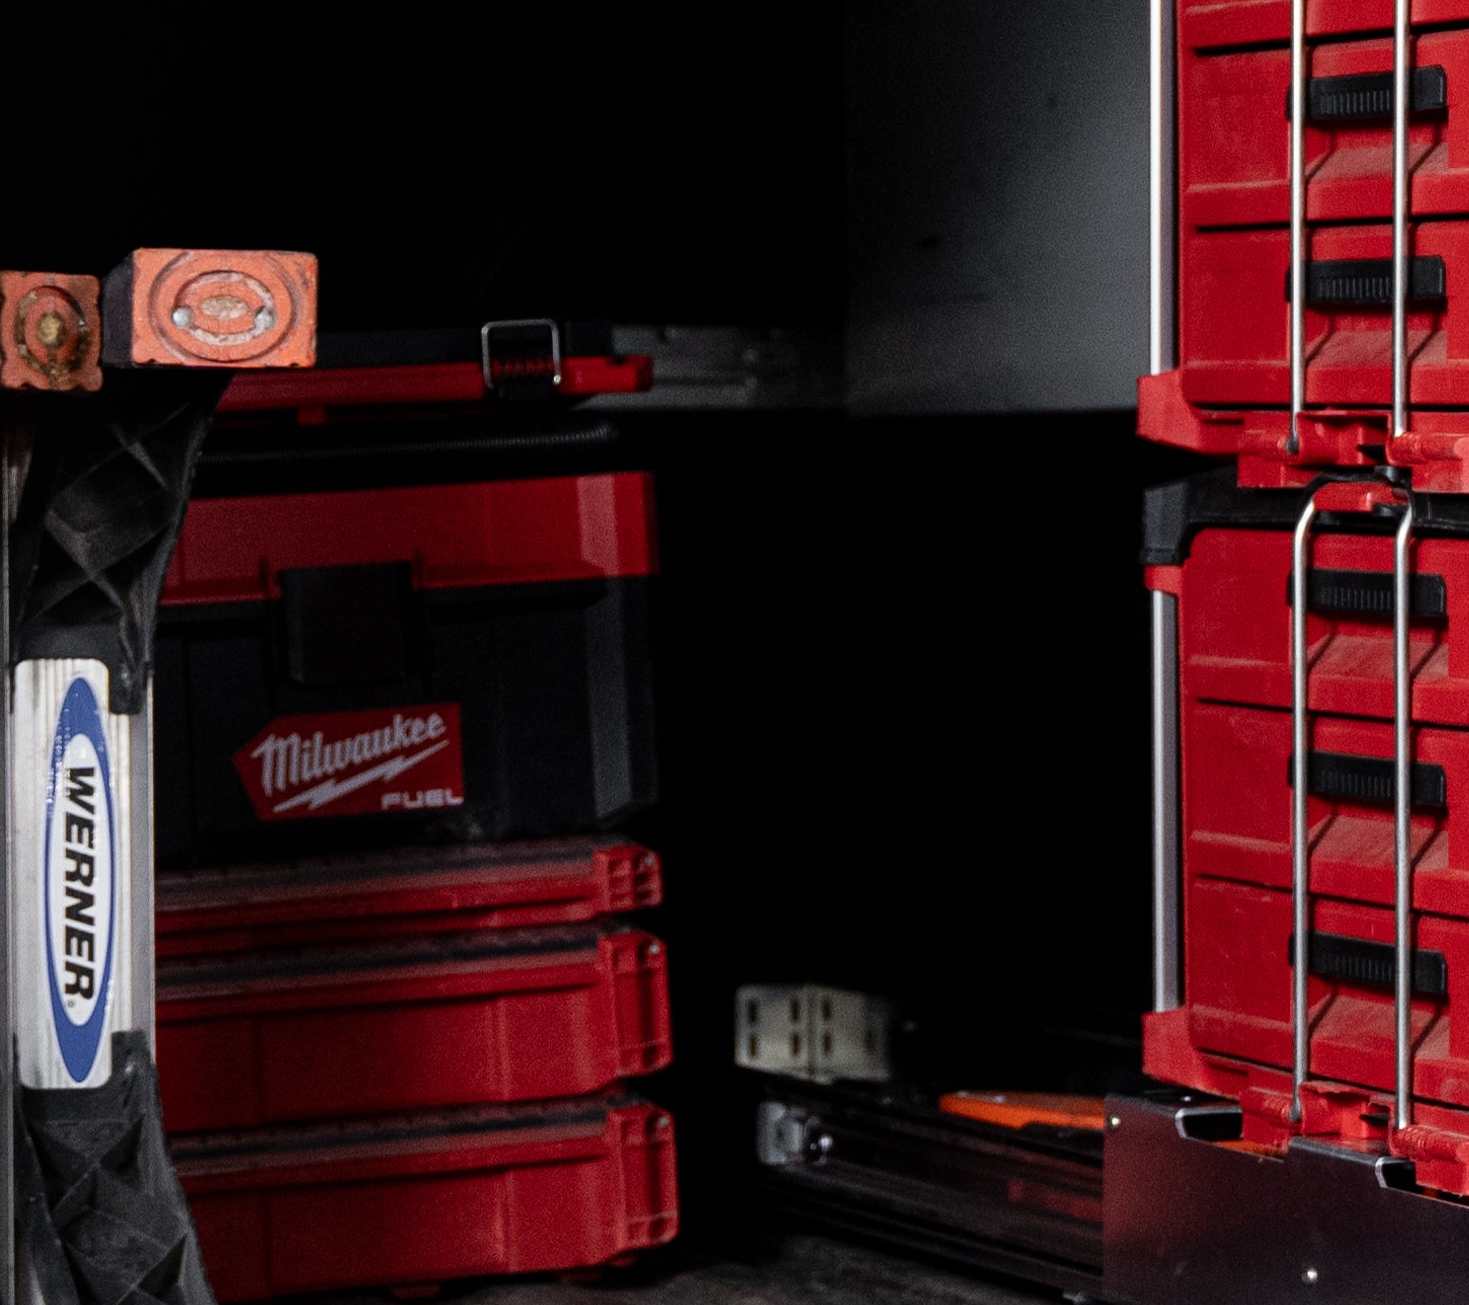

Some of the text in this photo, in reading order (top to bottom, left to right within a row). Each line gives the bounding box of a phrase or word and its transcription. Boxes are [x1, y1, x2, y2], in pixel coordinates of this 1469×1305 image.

[250, 712, 447, 799] Milwaukee
[381, 788, 464, 810] FUEL
[65, 767, 96, 1000] WERNER
